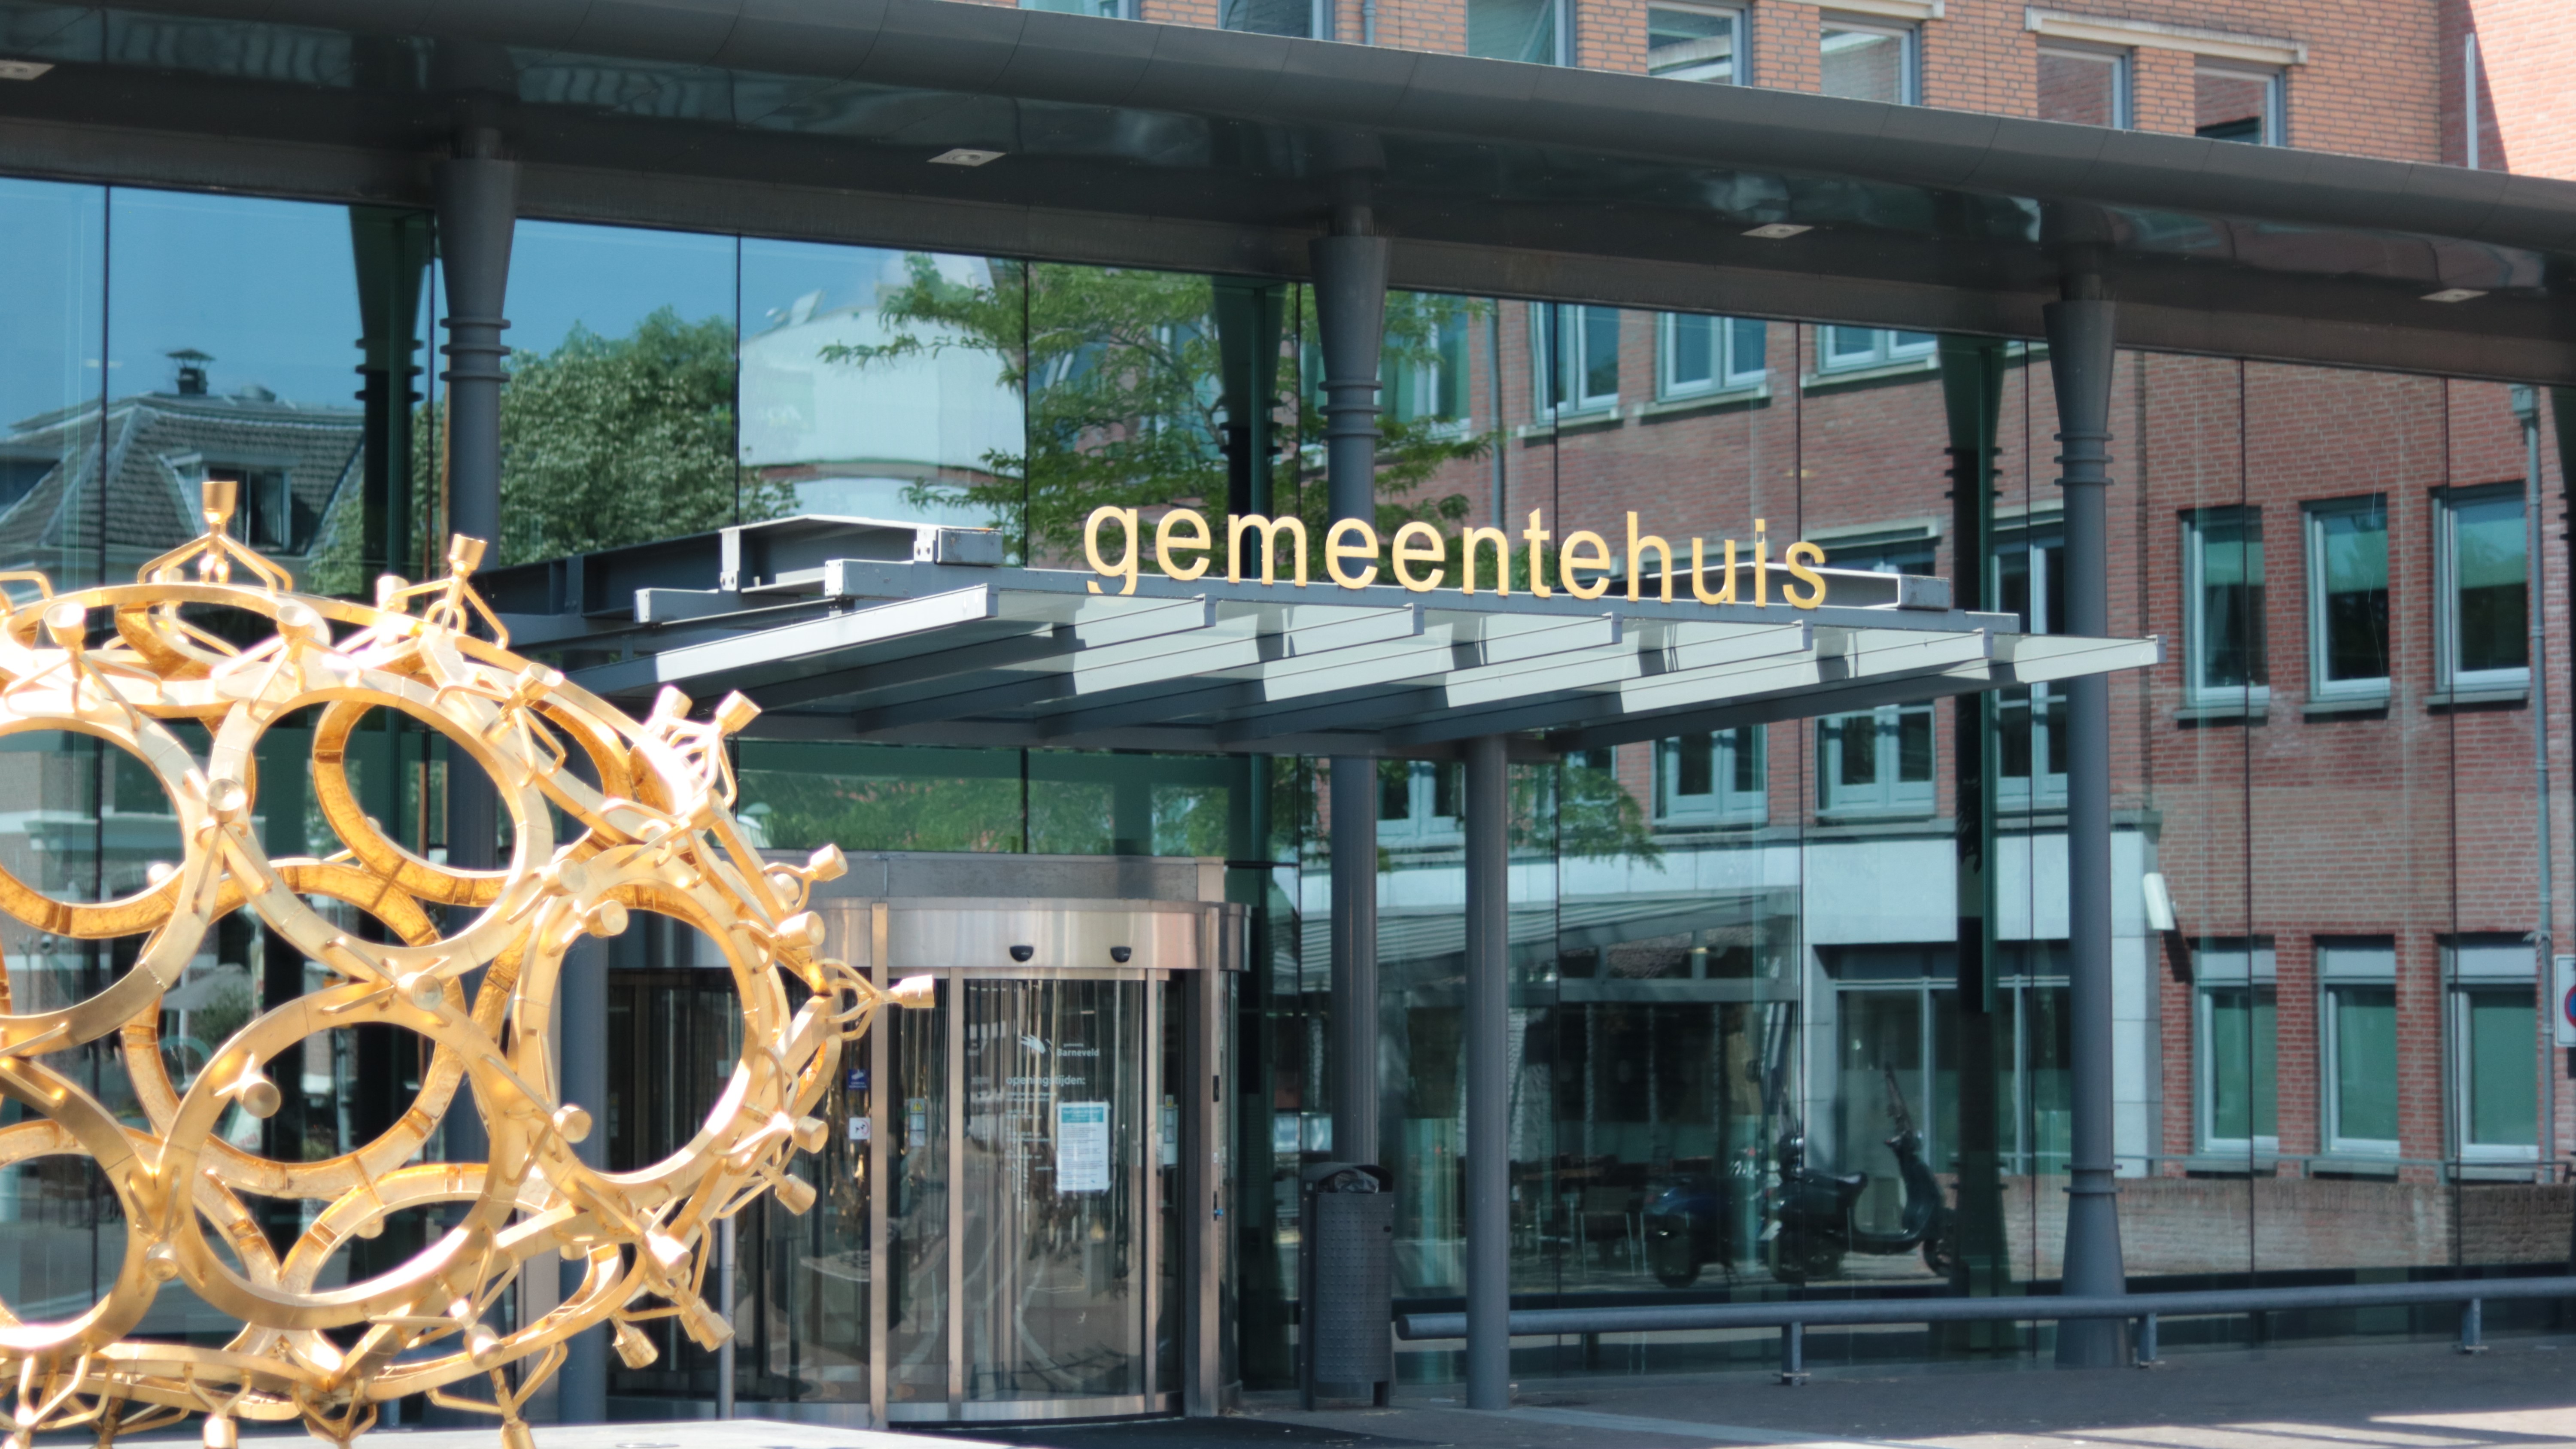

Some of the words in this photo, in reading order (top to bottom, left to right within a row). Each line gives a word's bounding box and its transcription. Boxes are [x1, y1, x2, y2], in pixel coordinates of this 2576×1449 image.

[1084, 506, 1826, 609] gemeentehuis
[1057, 1048, 1100, 1056] Barneveld
[1006, 1075, 1086, 1087] openingstijden:
